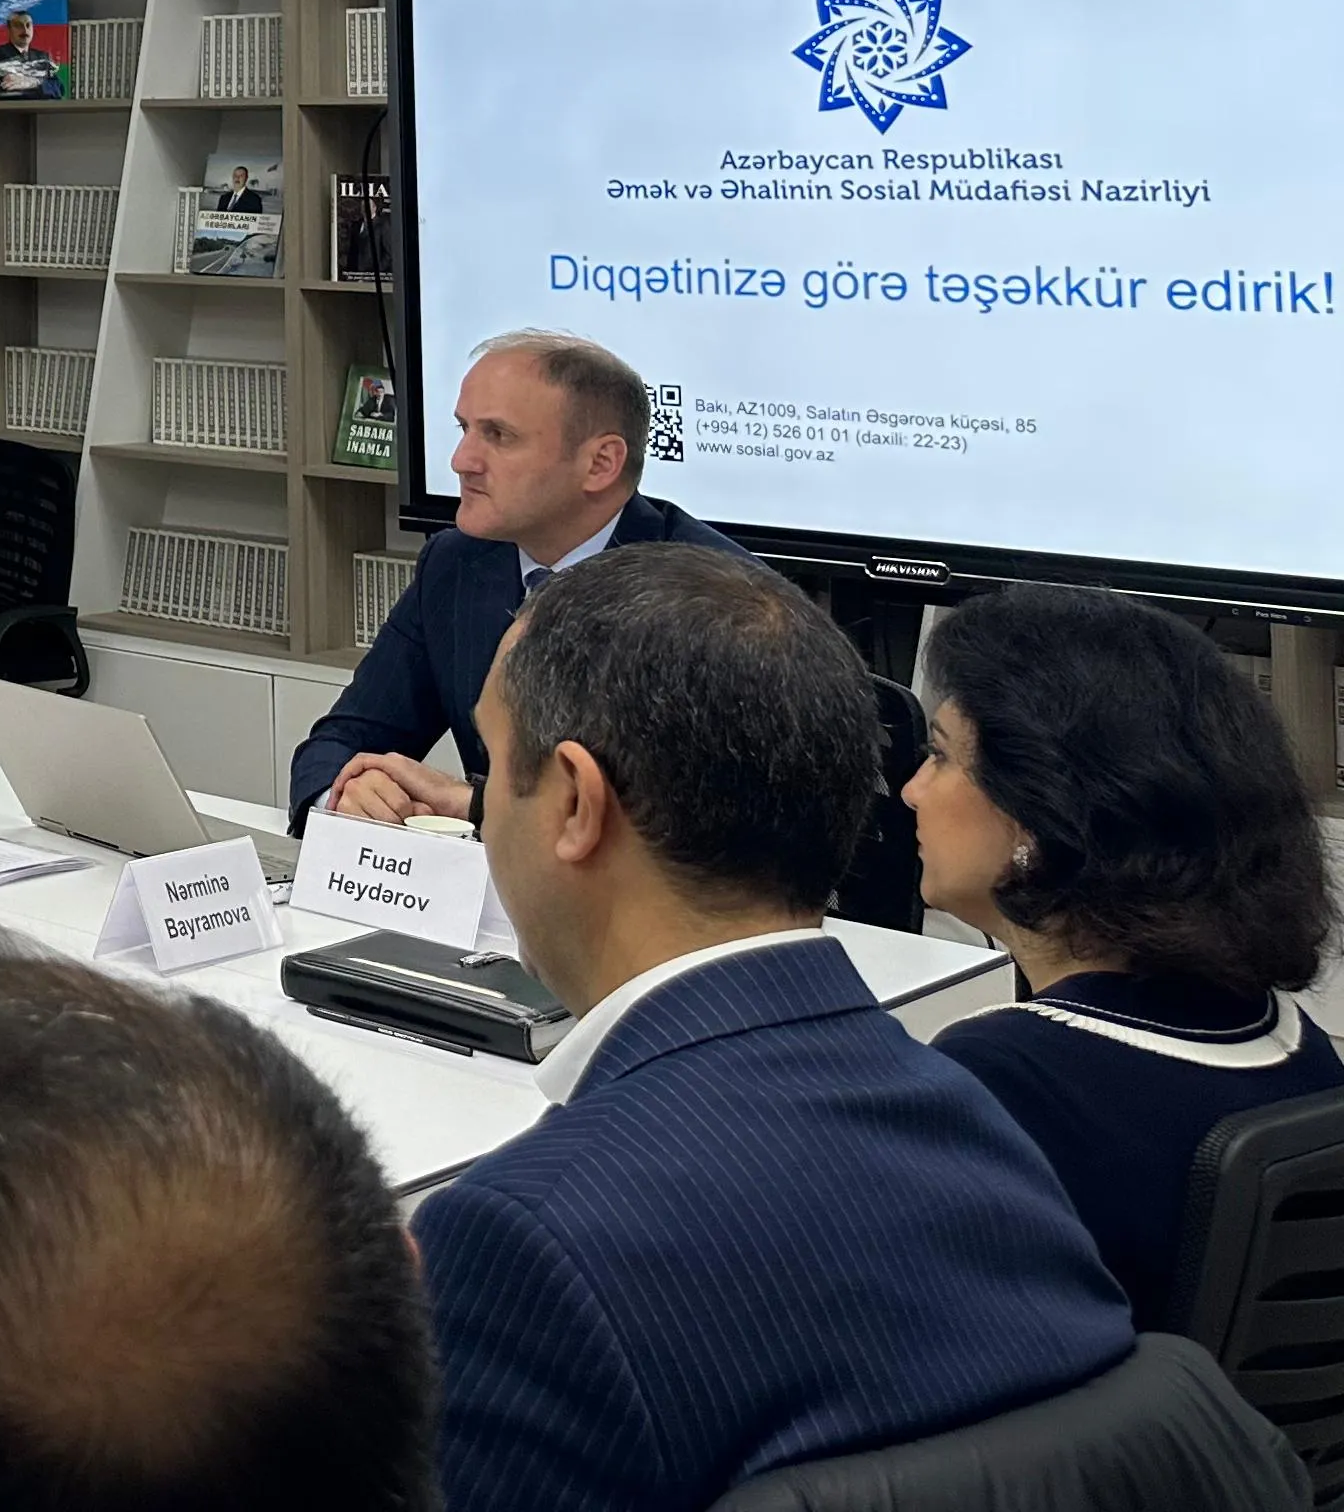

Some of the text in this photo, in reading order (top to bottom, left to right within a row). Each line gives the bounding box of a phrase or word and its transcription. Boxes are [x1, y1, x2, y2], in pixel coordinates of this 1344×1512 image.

[720, 148, 1064, 175] Azərbaycan Respublikası
[607, 178, 1212, 208] Əmək və Əhalinin Sosial Müdafiəsi Nazirliyi
[550, 254, 1335, 315] Diqqətinizə görə təşəkkür edirik!
[349, 423, 394, 442] SABAHA
[695, 399, 1038, 435] Bakı, AZ1009, Salatın Əsgərova küçəsi, 85
[696, 418, 969, 455] (+994 12) 526 01 01 (daxili: 22-23)
[696, 441, 836, 463] www.sosial.gov.az
[875, 563, 941, 578] HIKVISION
[358, 846, 413, 878] Fuad
[165, 873, 230, 904] Nərminə
[327, 871, 431, 914] Heydərov
[164, 905, 252, 940] Bayramova
